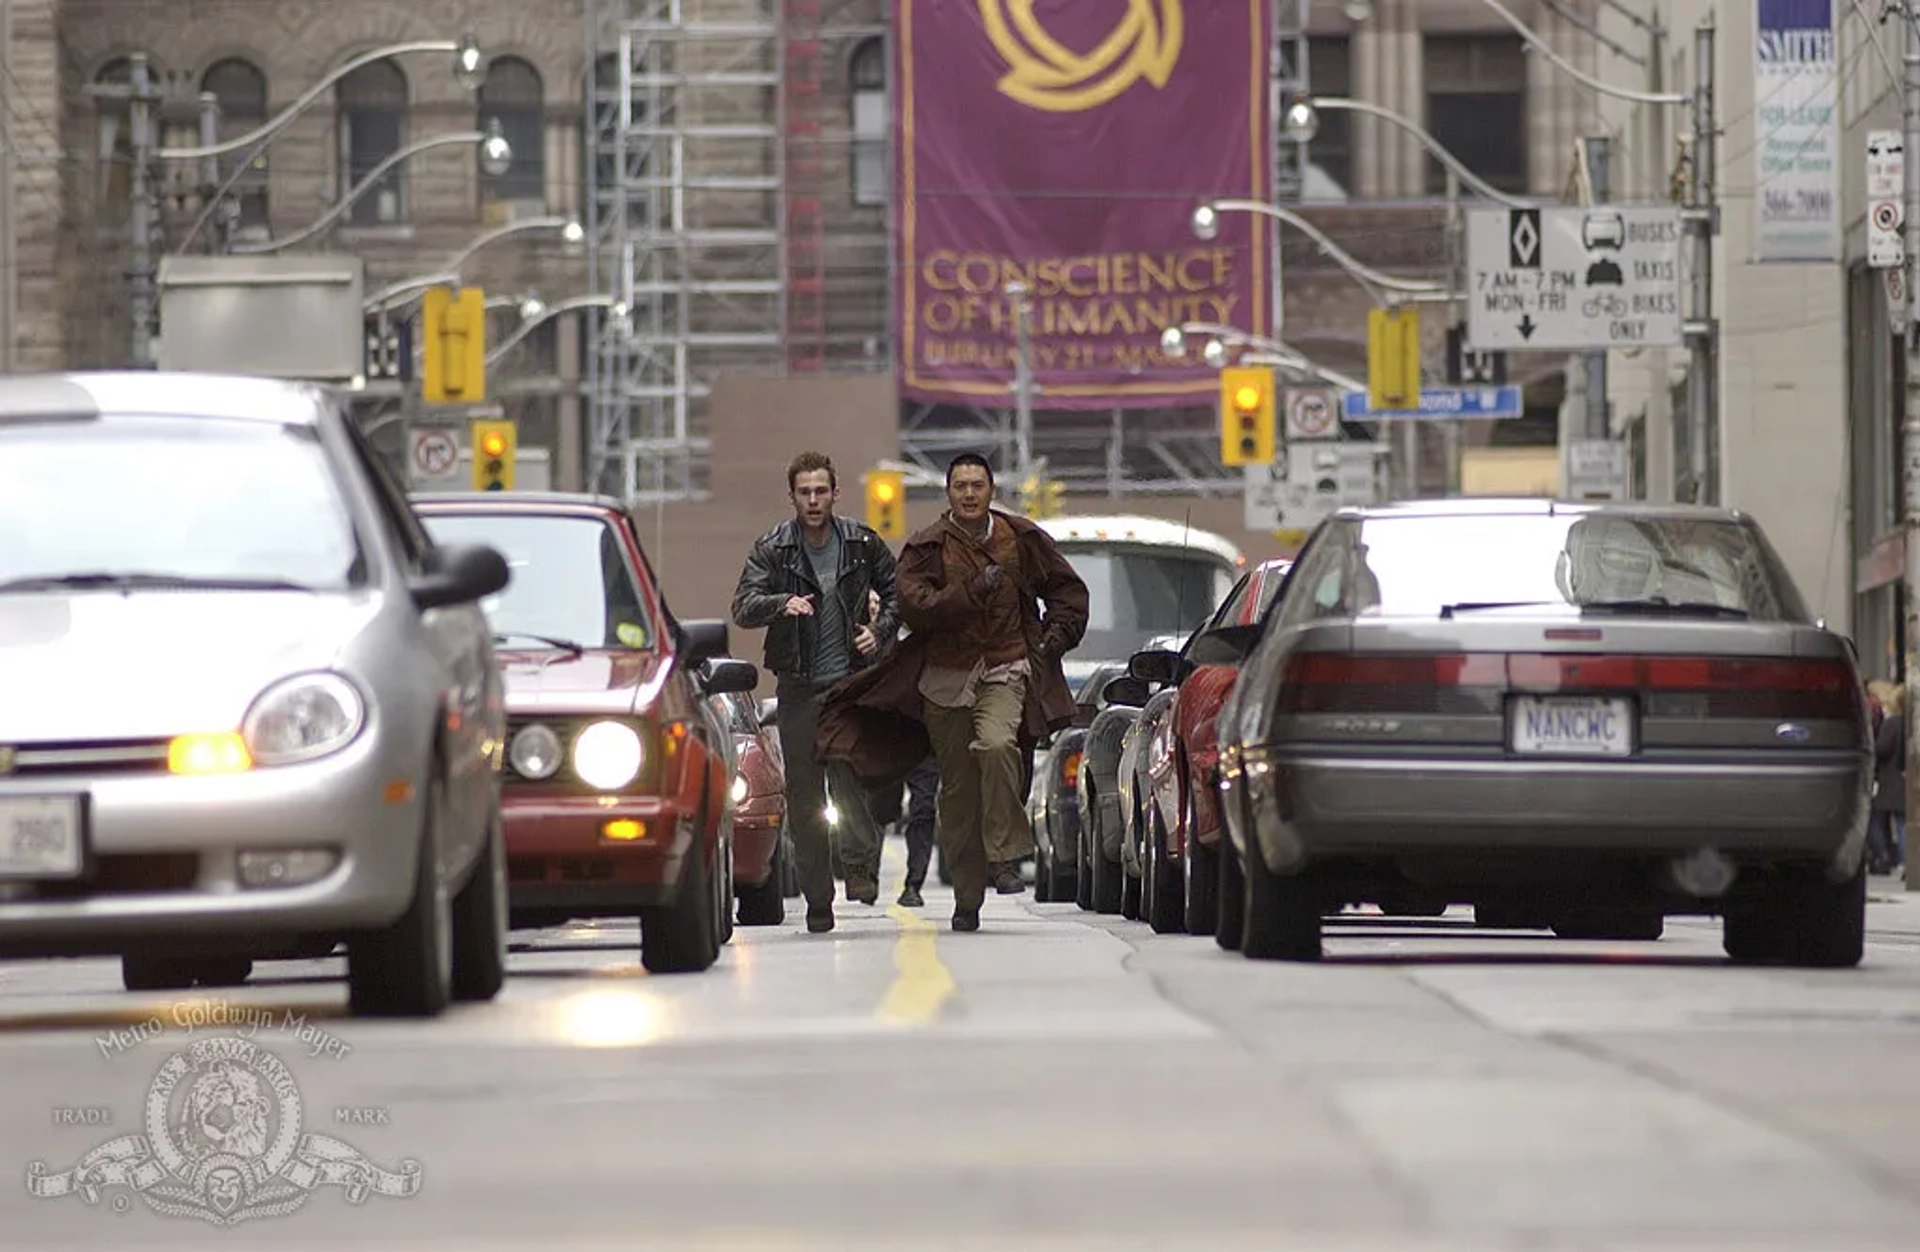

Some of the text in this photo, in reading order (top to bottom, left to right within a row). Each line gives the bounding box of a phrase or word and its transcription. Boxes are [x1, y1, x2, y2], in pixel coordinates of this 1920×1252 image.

[1759, 28, 1832, 62] SMITH
[1628, 222, 1676, 243] BUSES
[922, 248, 1233, 297] CONSCIENCE
[1476, 271, 1487, 291] 7
[1491, 271, 1519, 290] AM
[1550, 271, 1576, 291] PM
[1633, 260, 1674, 281] TAXIS
[1633, 293, 1676, 315] BIKES
[922, 294, 1239, 336] OF HUMANITY
[1610, 321, 1647, 341] ONLY
